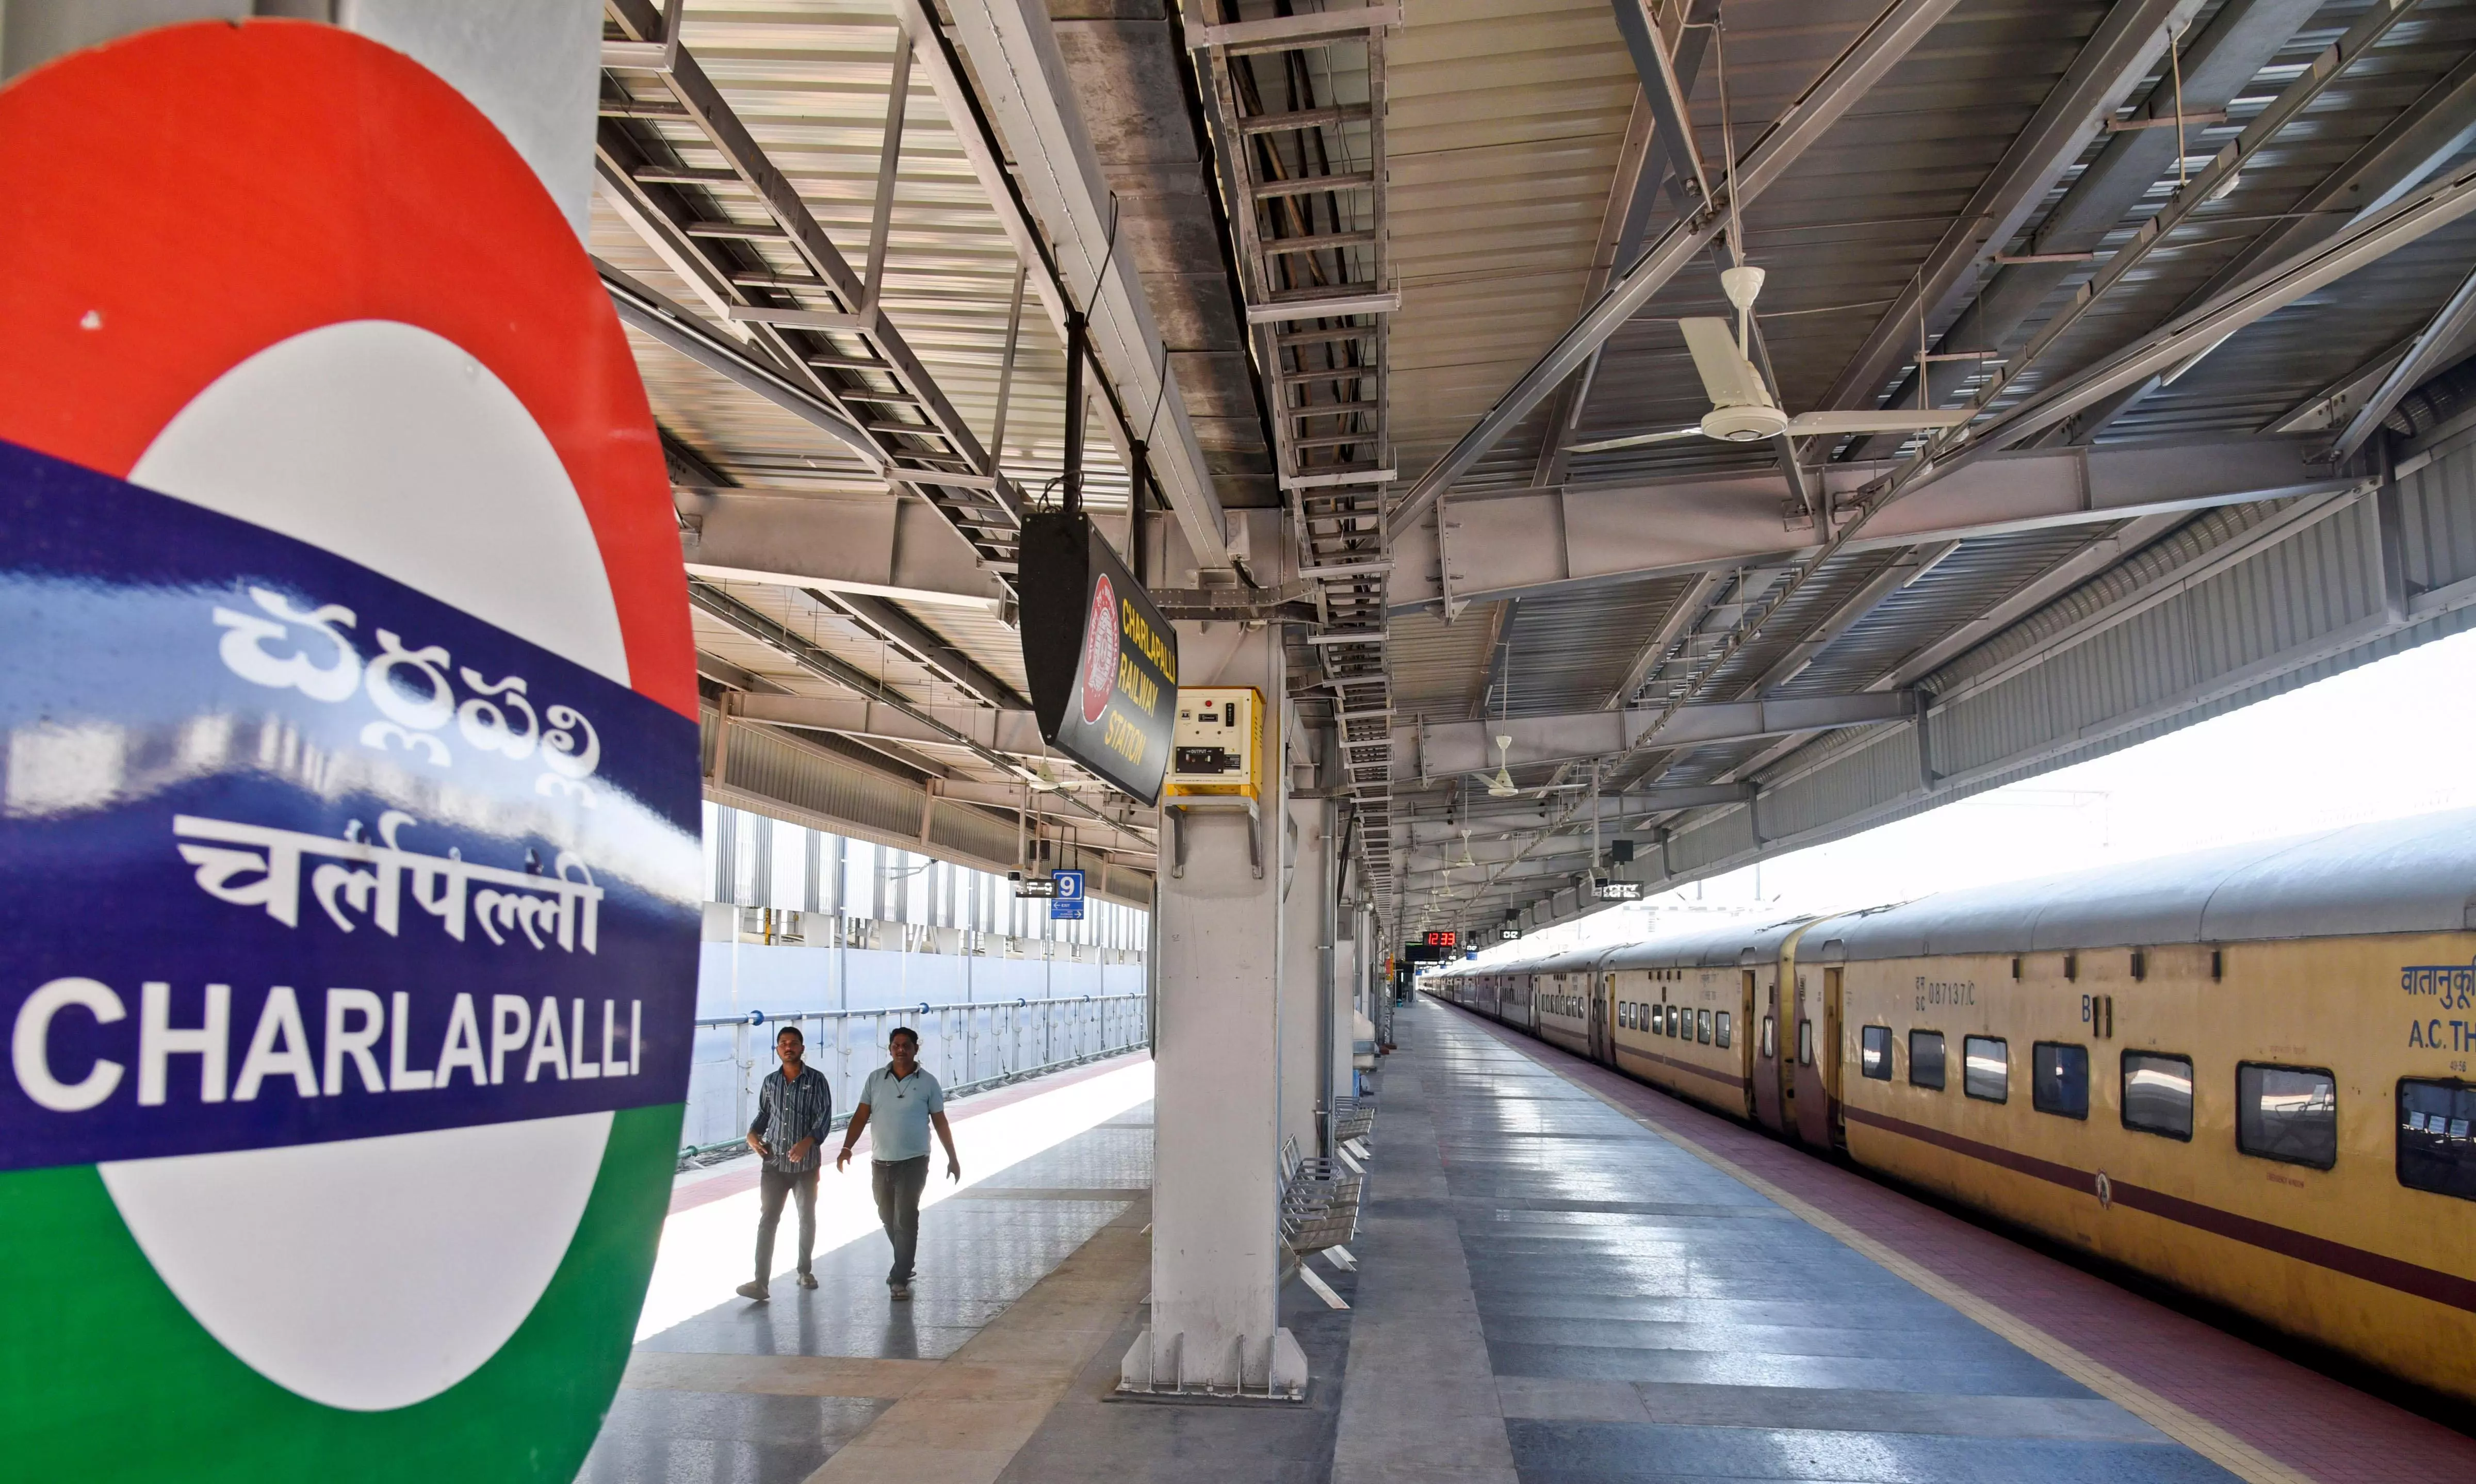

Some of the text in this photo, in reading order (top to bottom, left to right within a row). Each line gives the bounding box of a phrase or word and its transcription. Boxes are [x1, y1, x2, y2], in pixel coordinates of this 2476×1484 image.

[1122, 598, 1176, 685] CHARLAPALLI
[212, 585, 600, 808] చర్లపల్లి
[1118, 652, 1159, 717] RAILWAY
[1104, 710, 1147, 766] STATION
[173, 810, 604, 955] चर्लपल्ली
[1060, 876, 1074, 896] 9
[1915, 996, 1925, 1011] SC
[2082, 994, 2091, 1022] B
[12, 977, 641, 1112] CHARLAPALLI
[2408, 1019, 2447, 1049] A.C.
